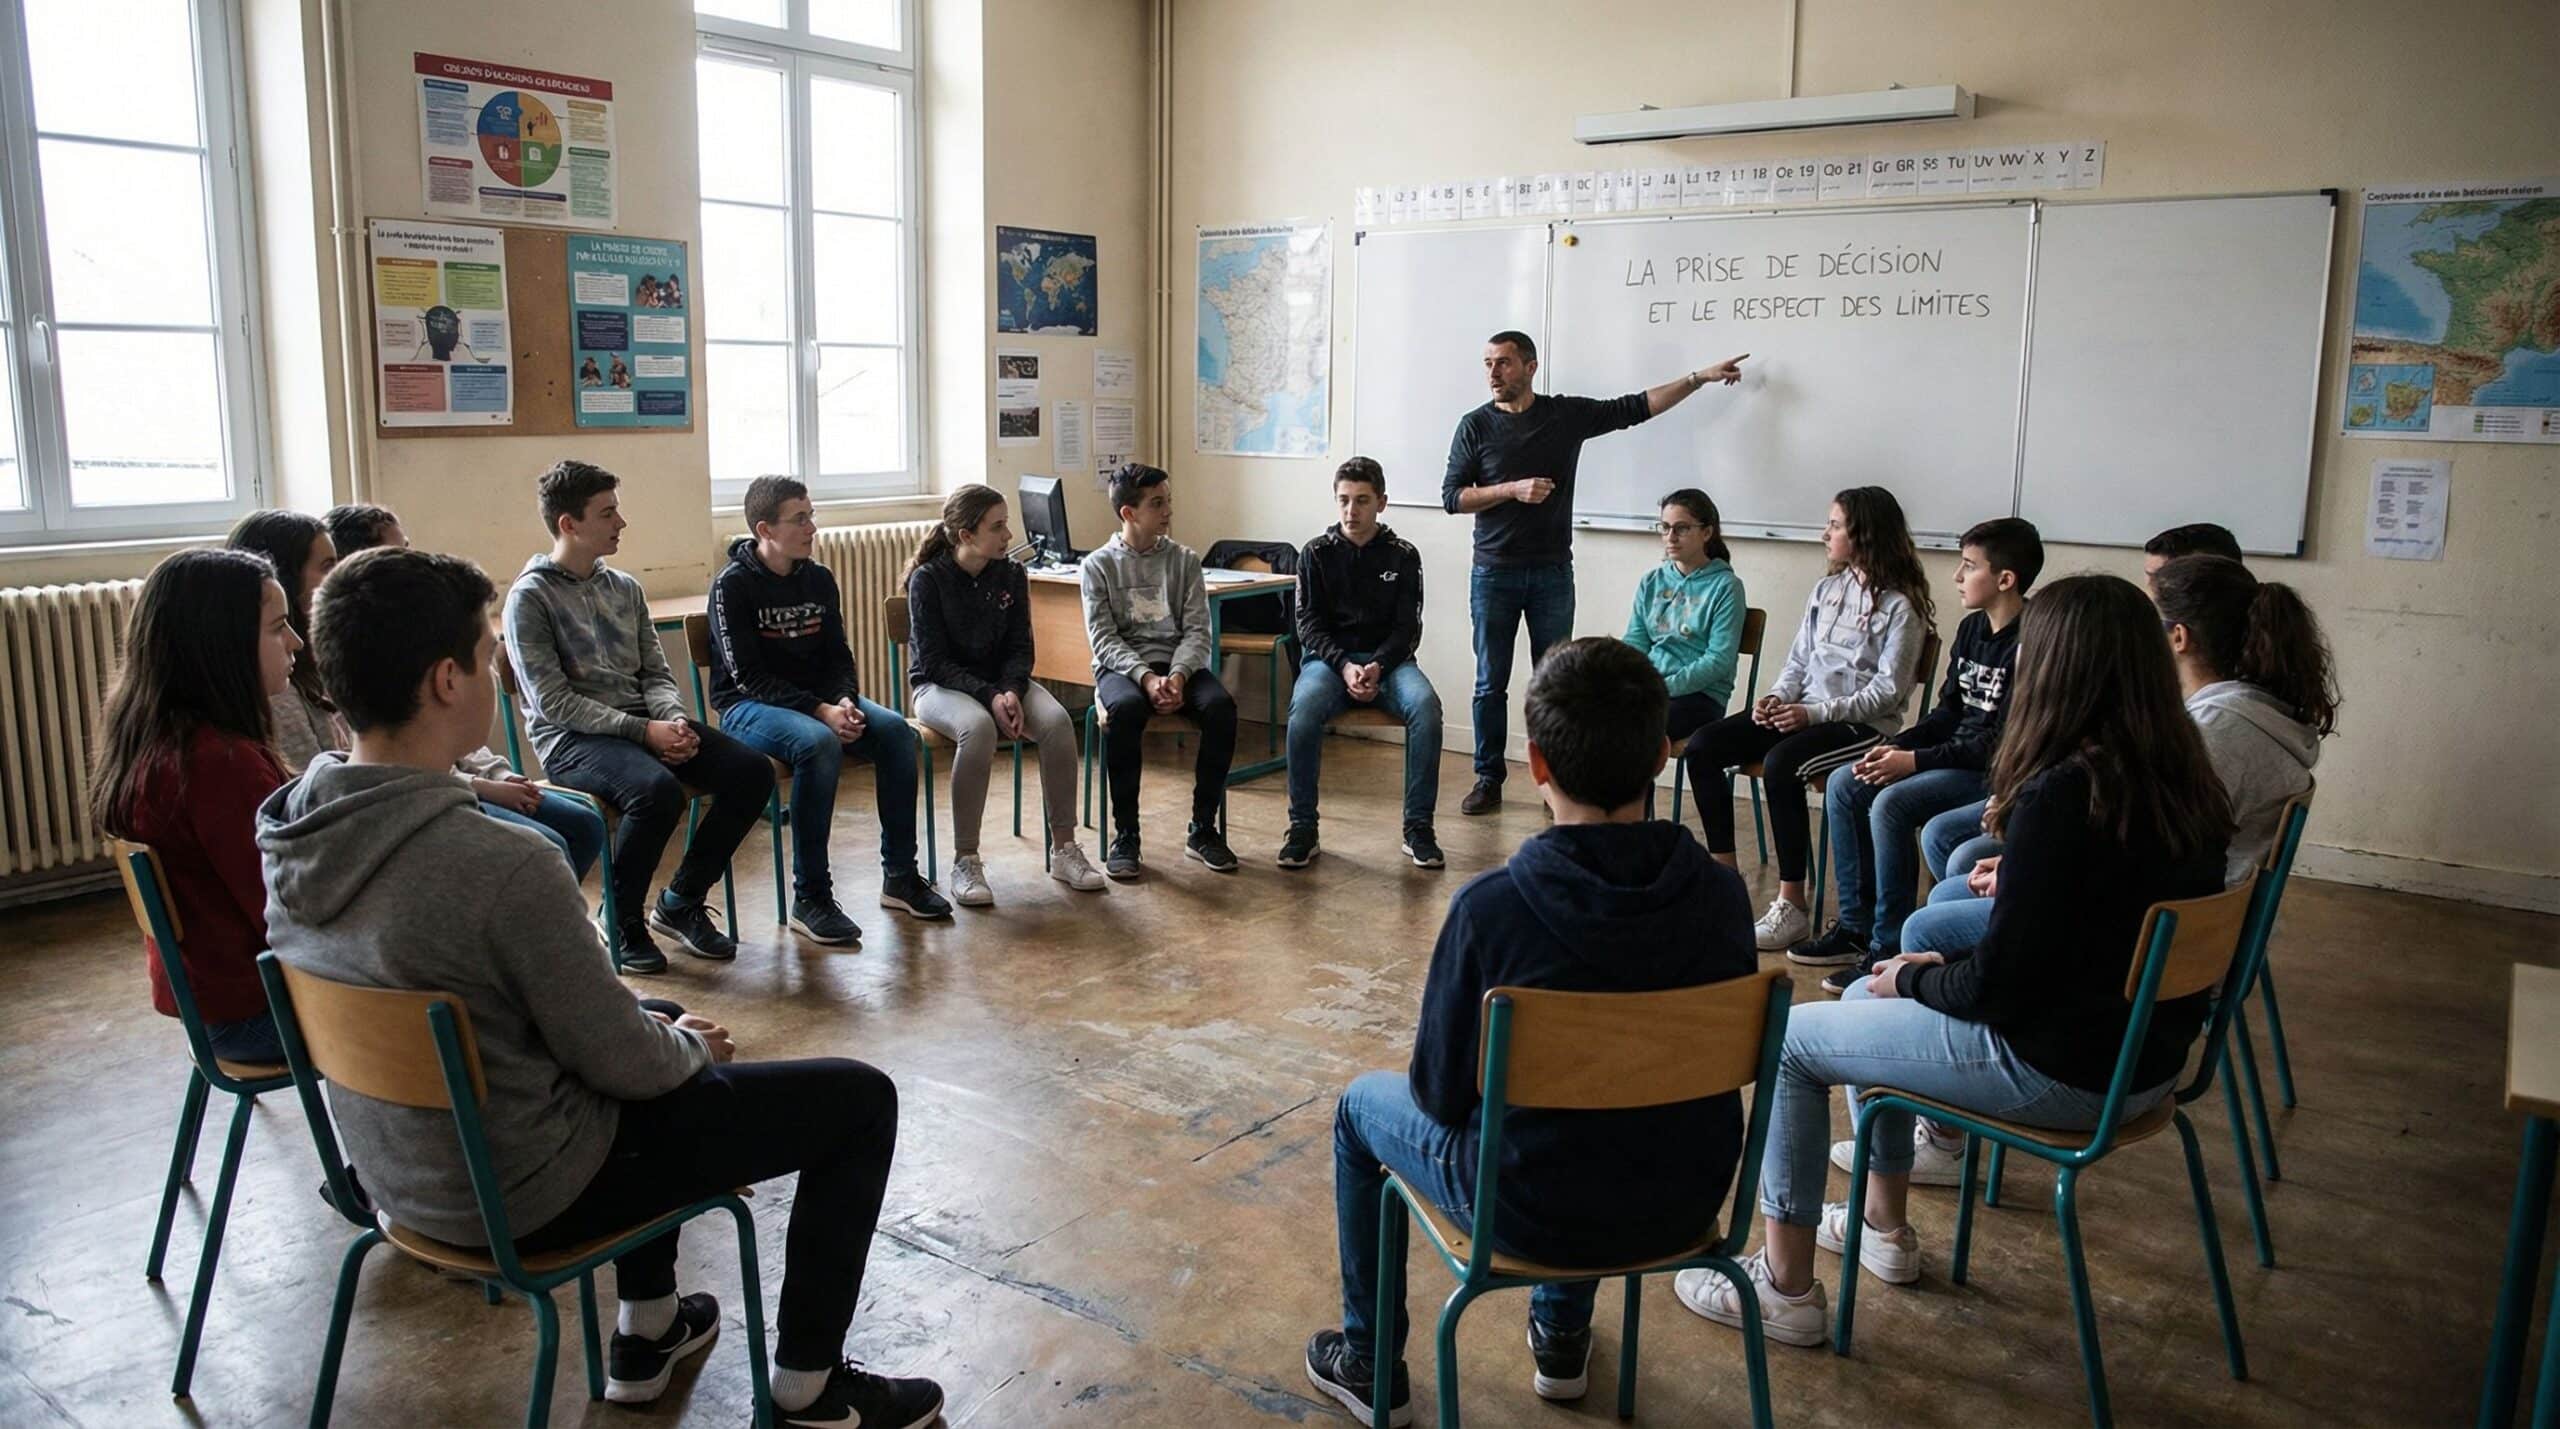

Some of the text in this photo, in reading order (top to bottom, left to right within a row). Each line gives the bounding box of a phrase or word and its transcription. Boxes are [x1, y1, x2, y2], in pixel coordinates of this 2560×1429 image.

[1799, 165, 1815, 177] 19
[2033, 151, 2045, 165] X
[2059, 149, 2070, 163] Y
[2084, 148, 2095, 162] Z
[1625, 242, 1942, 286] LA PRISE DE DÉCISION
[1648, 289, 1991, 324] ET LE RESPECT DES LIMITES
